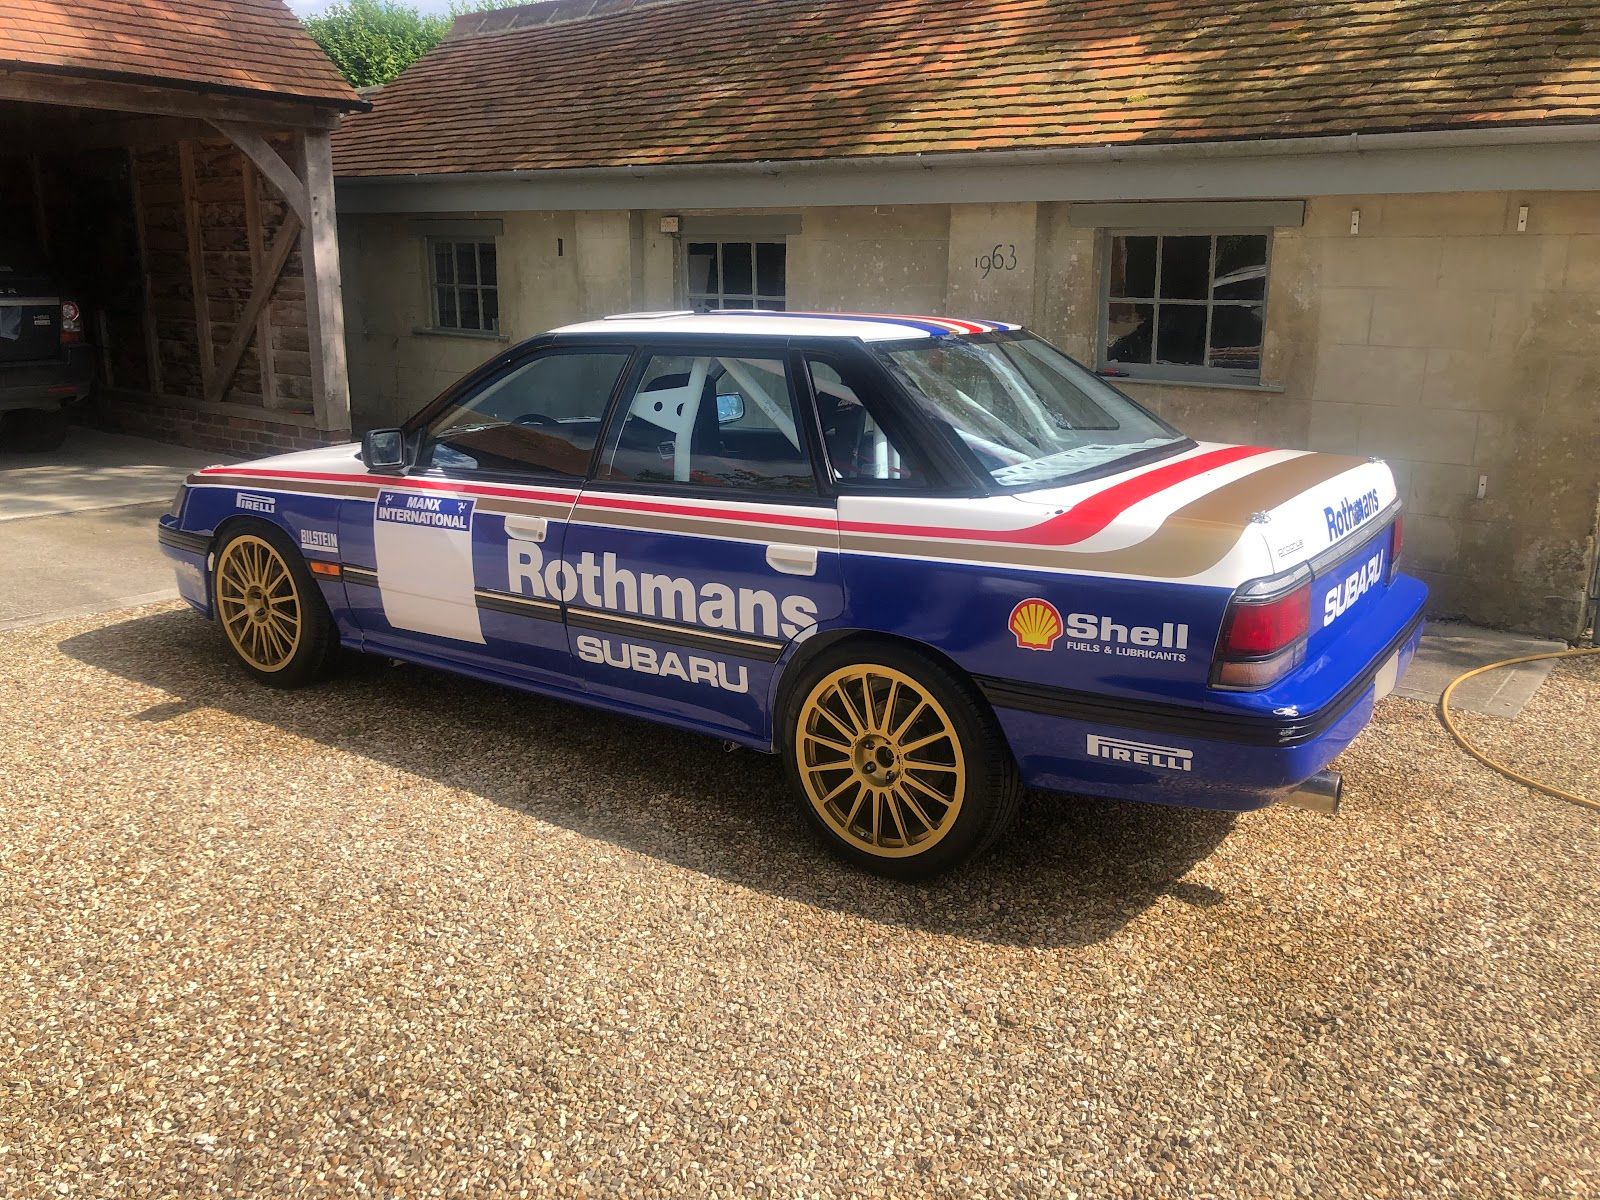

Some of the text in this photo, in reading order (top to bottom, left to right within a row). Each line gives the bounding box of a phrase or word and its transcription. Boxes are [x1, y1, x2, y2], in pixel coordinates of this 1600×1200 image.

[975, 244, 1017, 279] 1963
[235, 492, 275, 514] PIRELLI
[378, 507, 467, 529] INTERNATIONAL
[406, 496, 443, 511] MANX
[300, 529, 338, 547] BILSTEIN
[507, 538, 819, 643] Rothmans
[1323, 547, 1384, 628] SUBARU
[1066, 613, 1189, 650] Shell
[576, 635, 749, 694] SUBARU
[1066, 641, 1187, 662] FUELS & LUBRICANTS
[1086, 734, 1194, 772] PIRELLI
